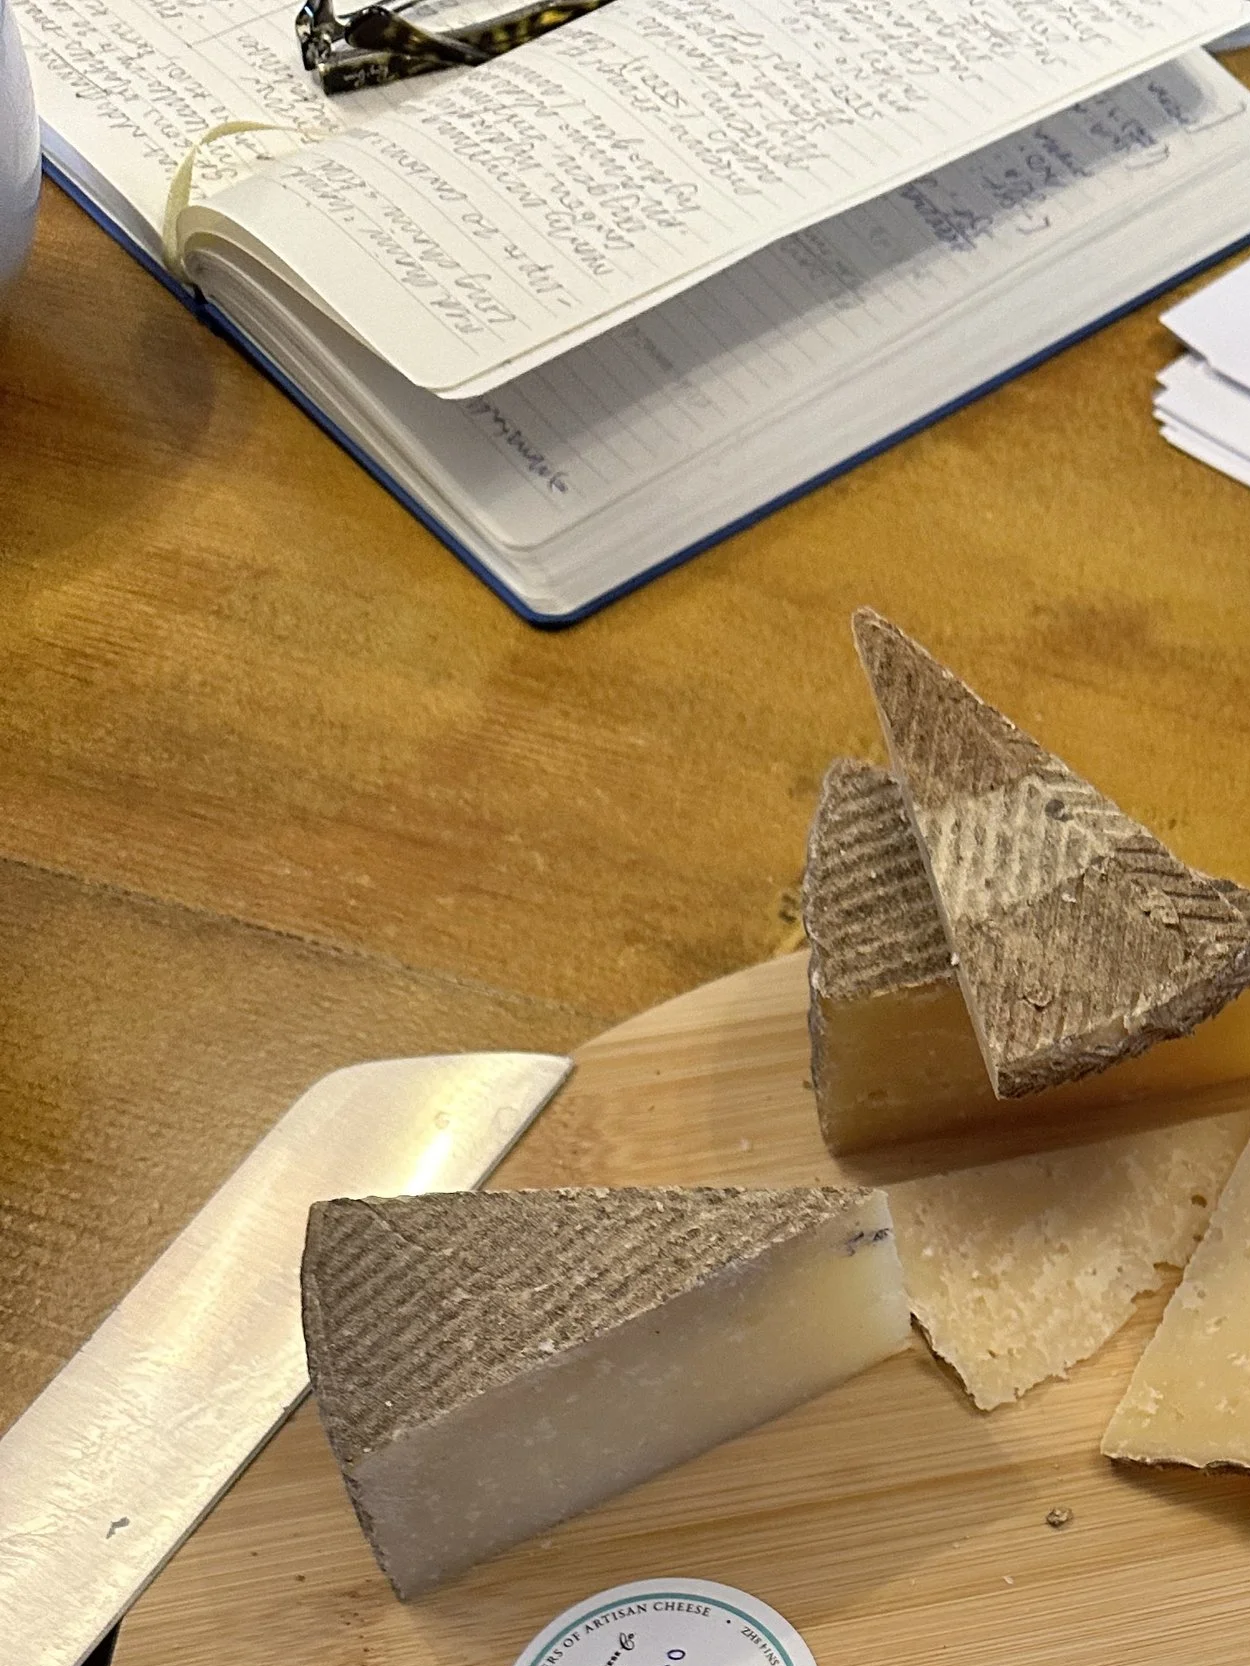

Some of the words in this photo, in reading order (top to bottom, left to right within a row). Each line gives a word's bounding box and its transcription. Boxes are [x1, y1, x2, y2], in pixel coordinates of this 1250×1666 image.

[563, 1633, 581, 1649] OF
[585, 1603, 648, 1635] ARTISAN
[652, 1601, 712, 1618] CHEESE
